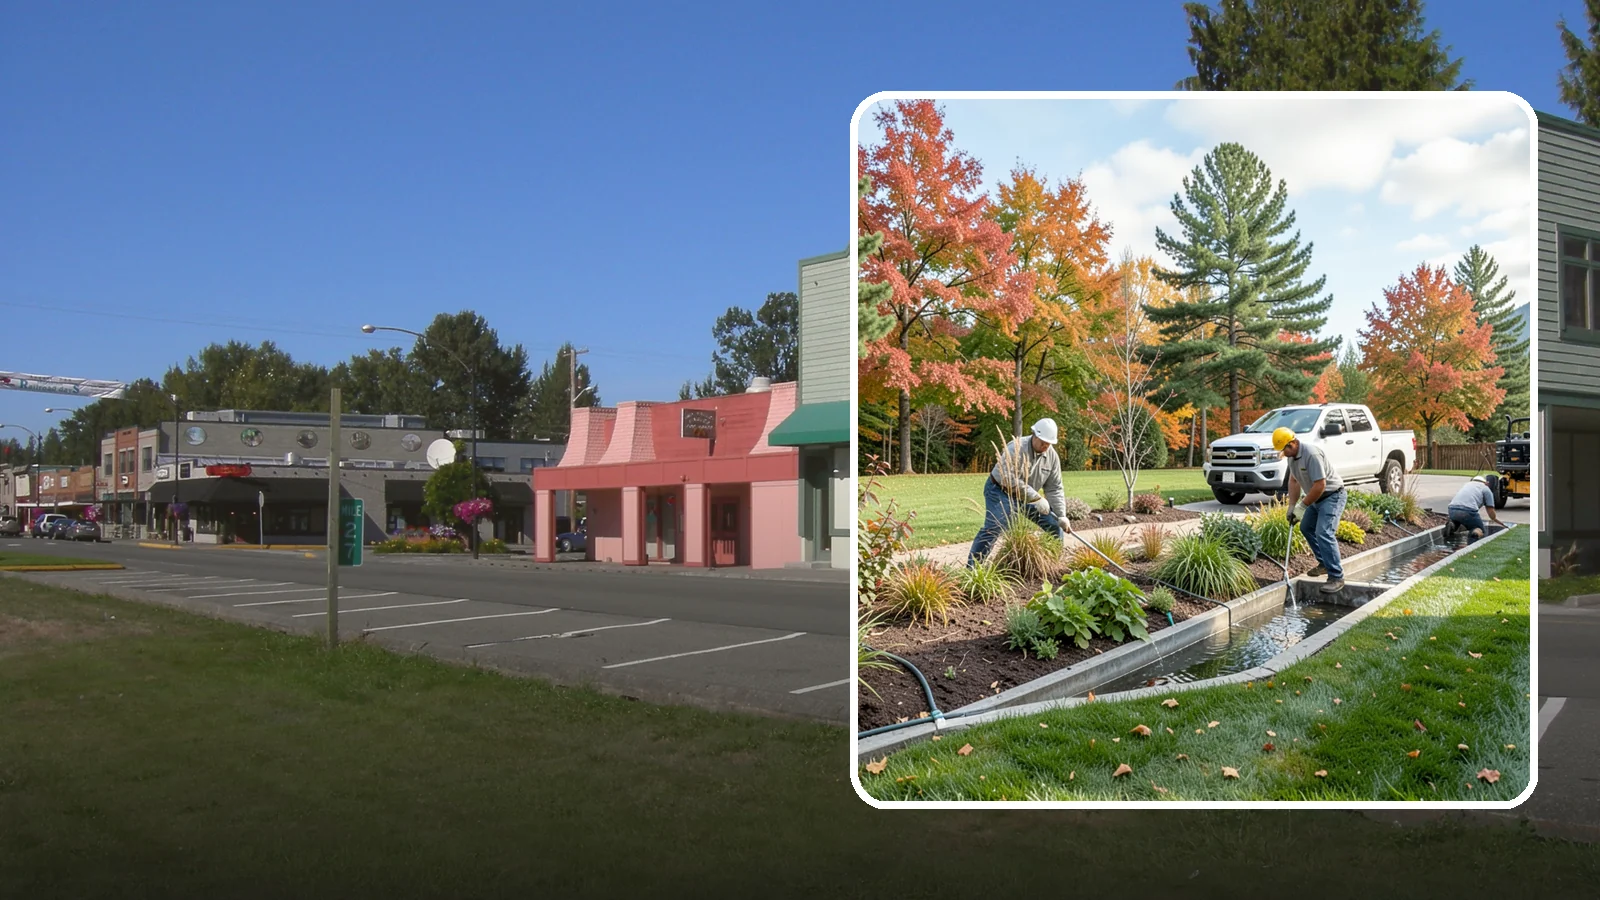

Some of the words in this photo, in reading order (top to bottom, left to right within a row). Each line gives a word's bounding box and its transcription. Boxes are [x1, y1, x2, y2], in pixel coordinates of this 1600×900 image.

[341, 505, 361, 517] MILE
[344, 521, 357, 539] 2
[344, 543, 356, 559] 7
